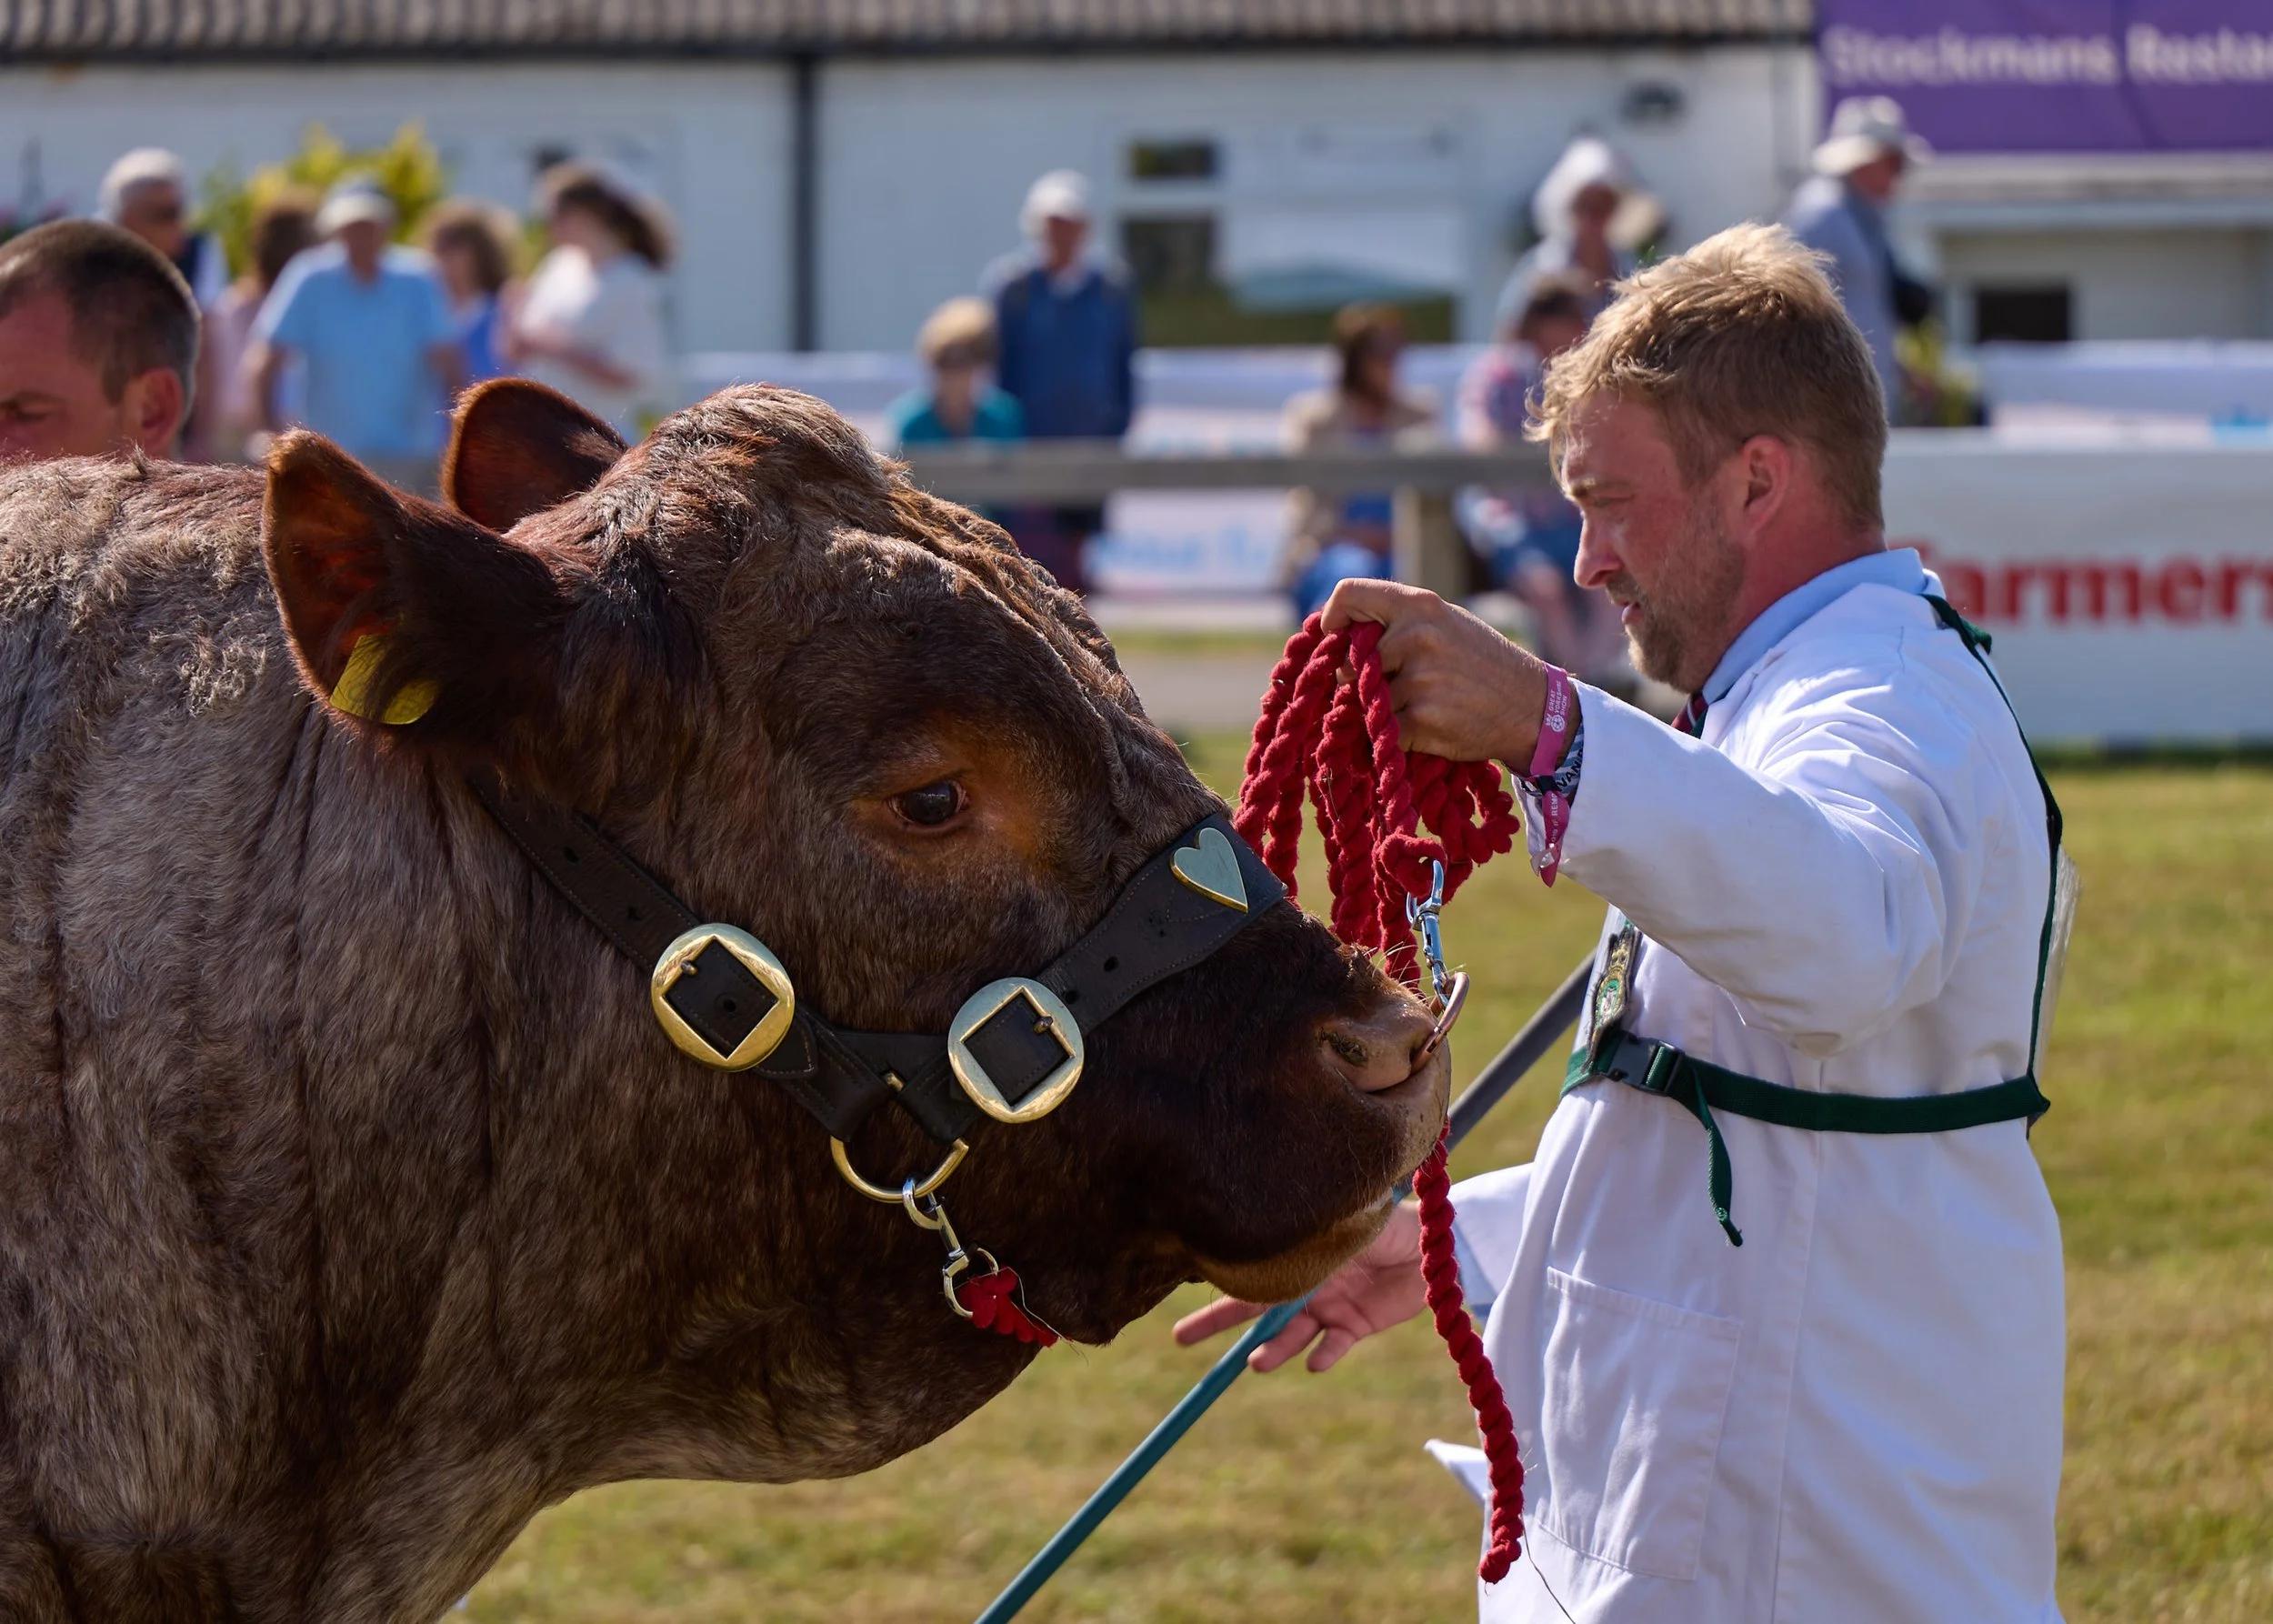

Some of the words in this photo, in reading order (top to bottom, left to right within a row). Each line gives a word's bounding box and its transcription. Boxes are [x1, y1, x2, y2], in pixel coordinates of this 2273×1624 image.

[1822, 24, 2118, 85] Stockmans
[2125, 23, 2273, 85] Resta
[1888, 543, 2273, 623] armer
[1559, 694, 1567, 716] SHOW
